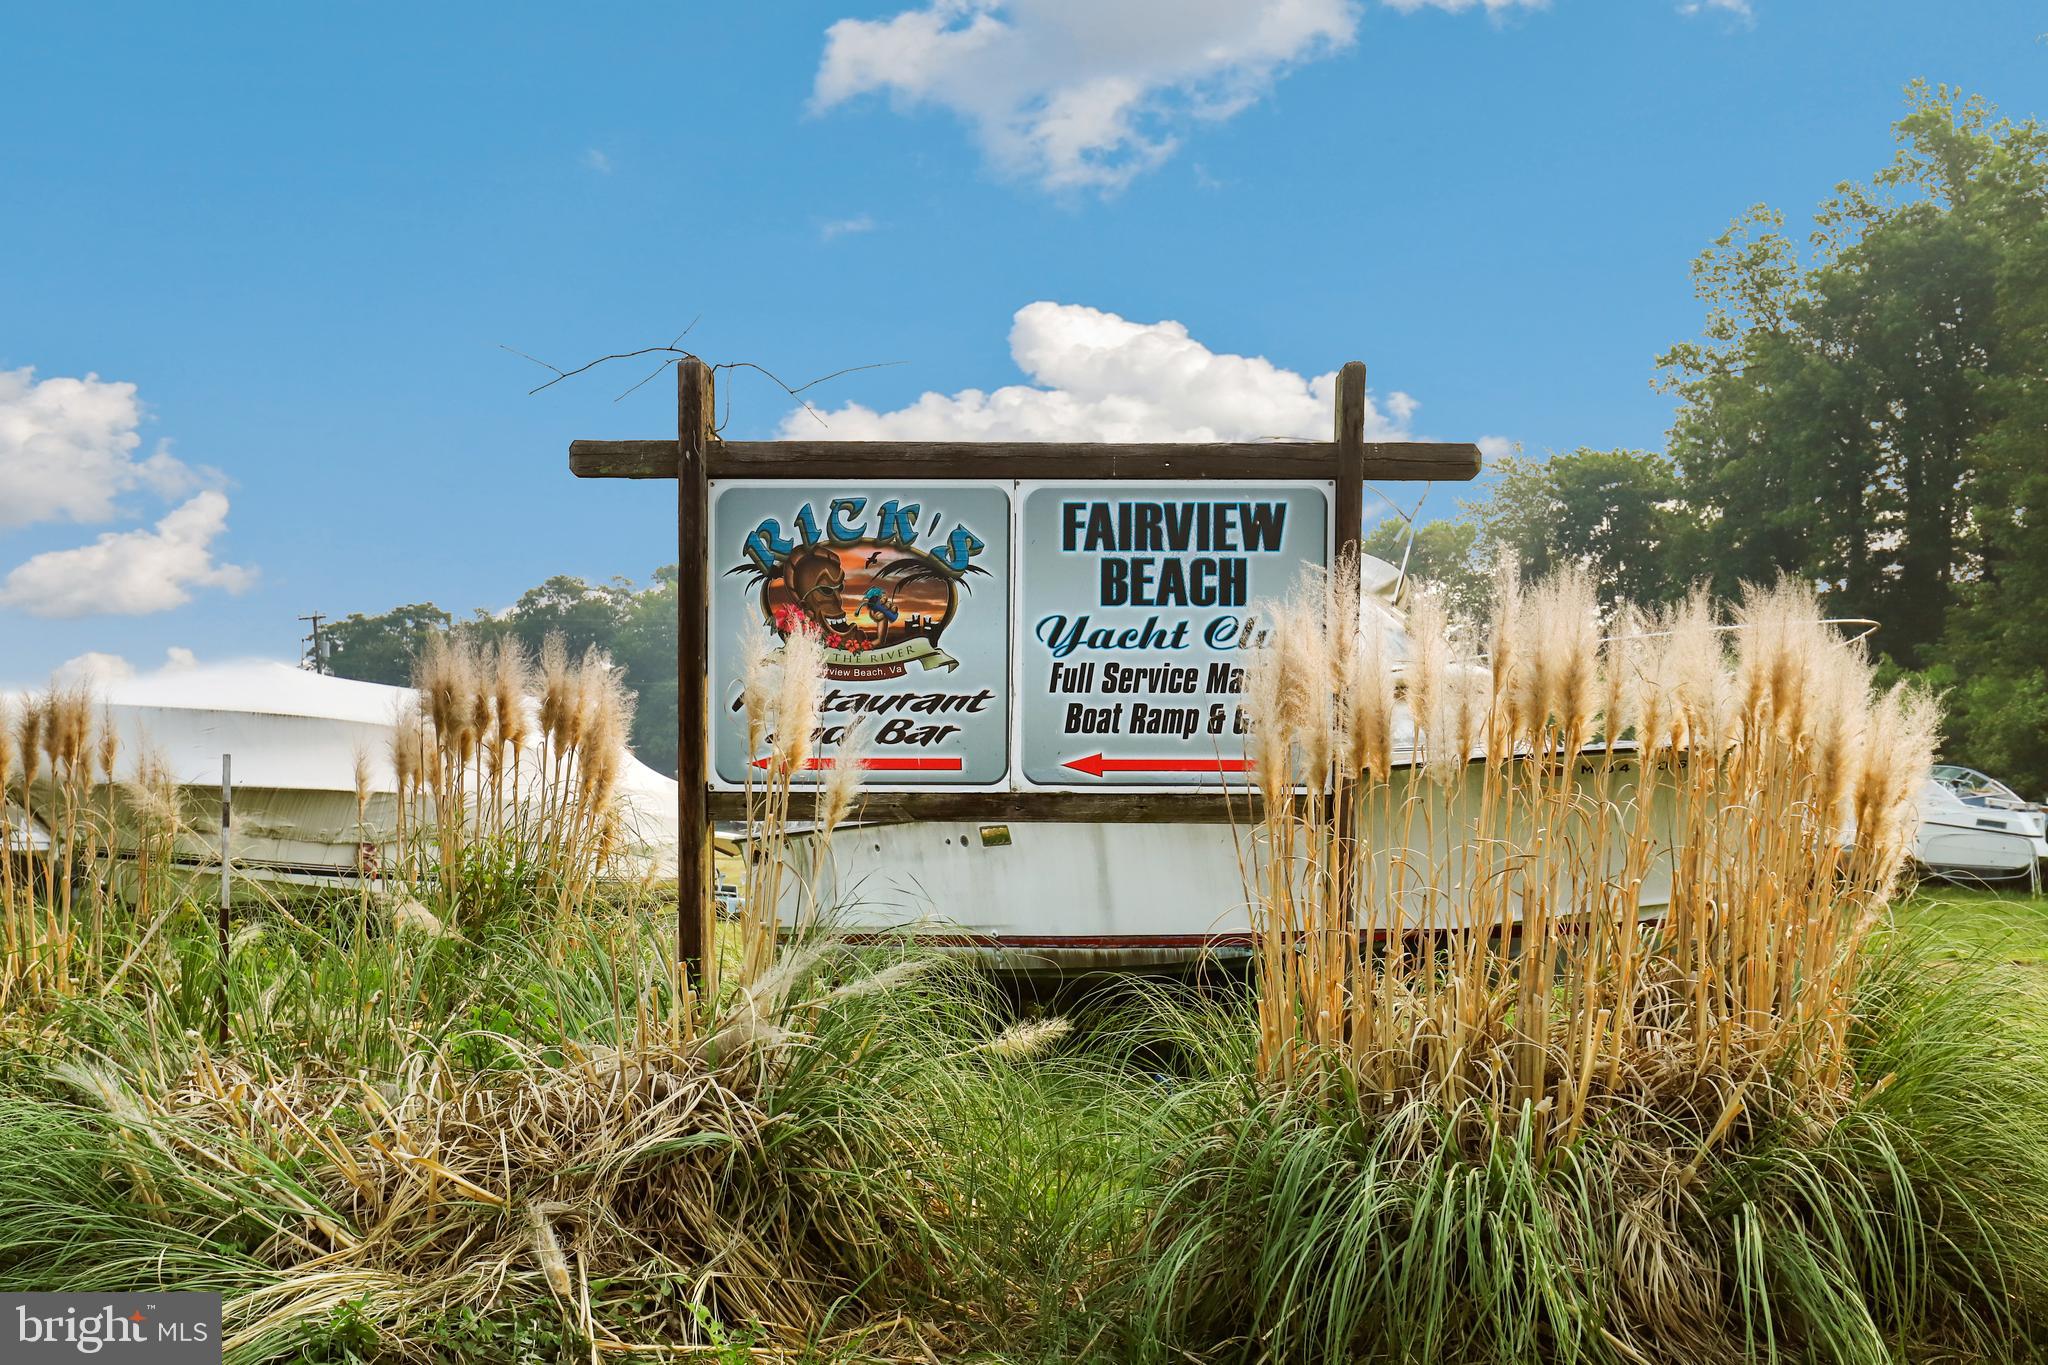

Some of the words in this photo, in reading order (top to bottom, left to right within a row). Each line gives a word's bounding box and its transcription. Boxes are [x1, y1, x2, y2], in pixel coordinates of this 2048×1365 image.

[743, 497, 985, 574] RICK'S
[1062, 502, 1287, 552] FAIRVIEW
[1100, 557, 1247, 607] BEACH
[833, 653, 861, 663] THE
[870, 645, 915, 663] RIVER
[1036, 615, 1190, 658] Yacht
[889, 665, 902, 674] Va
[1049, 662, 1095, 693] Full
[1102, 662, 1199, 693] Service
[875, 718, 961, 746] Bar
[1064, 703, 1122, 734] Boat
[1129, 703, 1200, 740] Ramp
[1207, 703, 1226, 734] &
